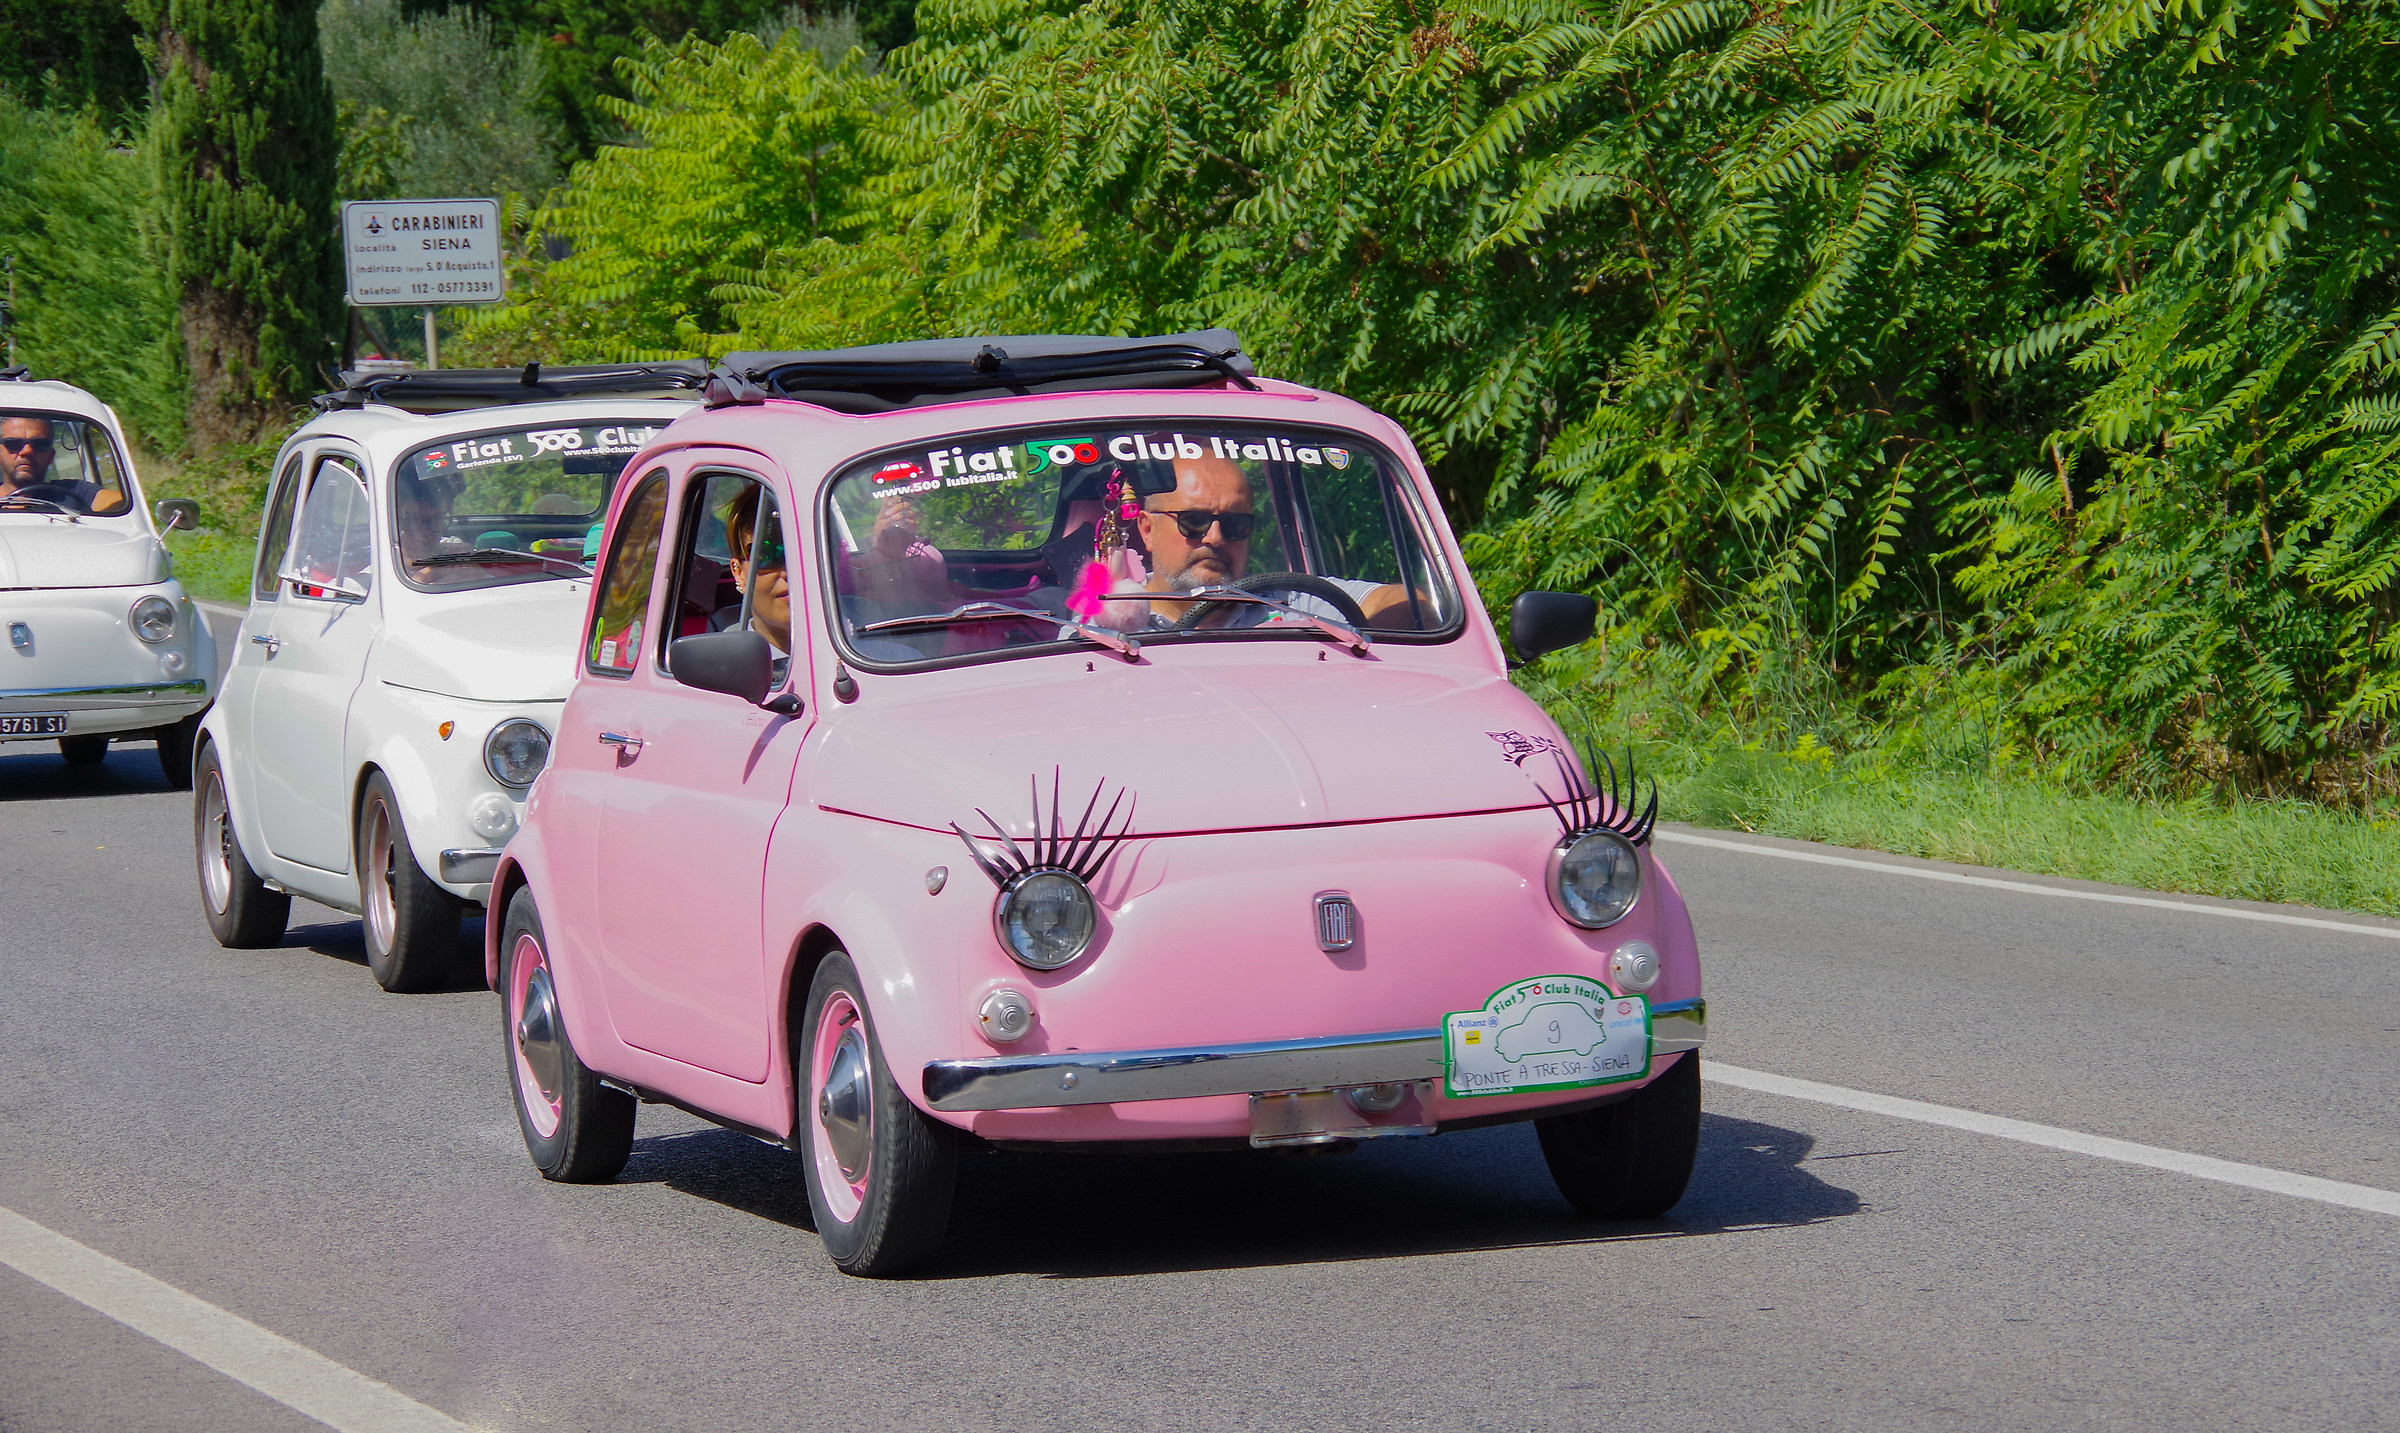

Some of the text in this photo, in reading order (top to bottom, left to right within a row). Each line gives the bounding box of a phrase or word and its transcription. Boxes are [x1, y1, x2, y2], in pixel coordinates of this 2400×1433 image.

[392, 214, 483, 231] CARABINIERI
[422, 238, 471, 250] SIENA
[359, 286, 400, 296] telefoni
[451, 438, 513, 462] Fiat
[526, 428, 583, 458] 500
[927, 433, 1323, 477] Fiat 500 Club Italia
[2, 717, 63, 733] 5761 SI
[1323, 903, 1348, 941] FIAT
[1493, 994, 1517, 1015] Fiat
[1544, 983, 1571, 994] Club
[1575, 985, 1605, 1005] Italia
[1457, 1018, 1487, 1028] Allianz
[1548, 1020, 1561, 1043] 9
[1464, 1069, 1512, 1089] PONTE
[1519, 1064, 1529, 1080] A
